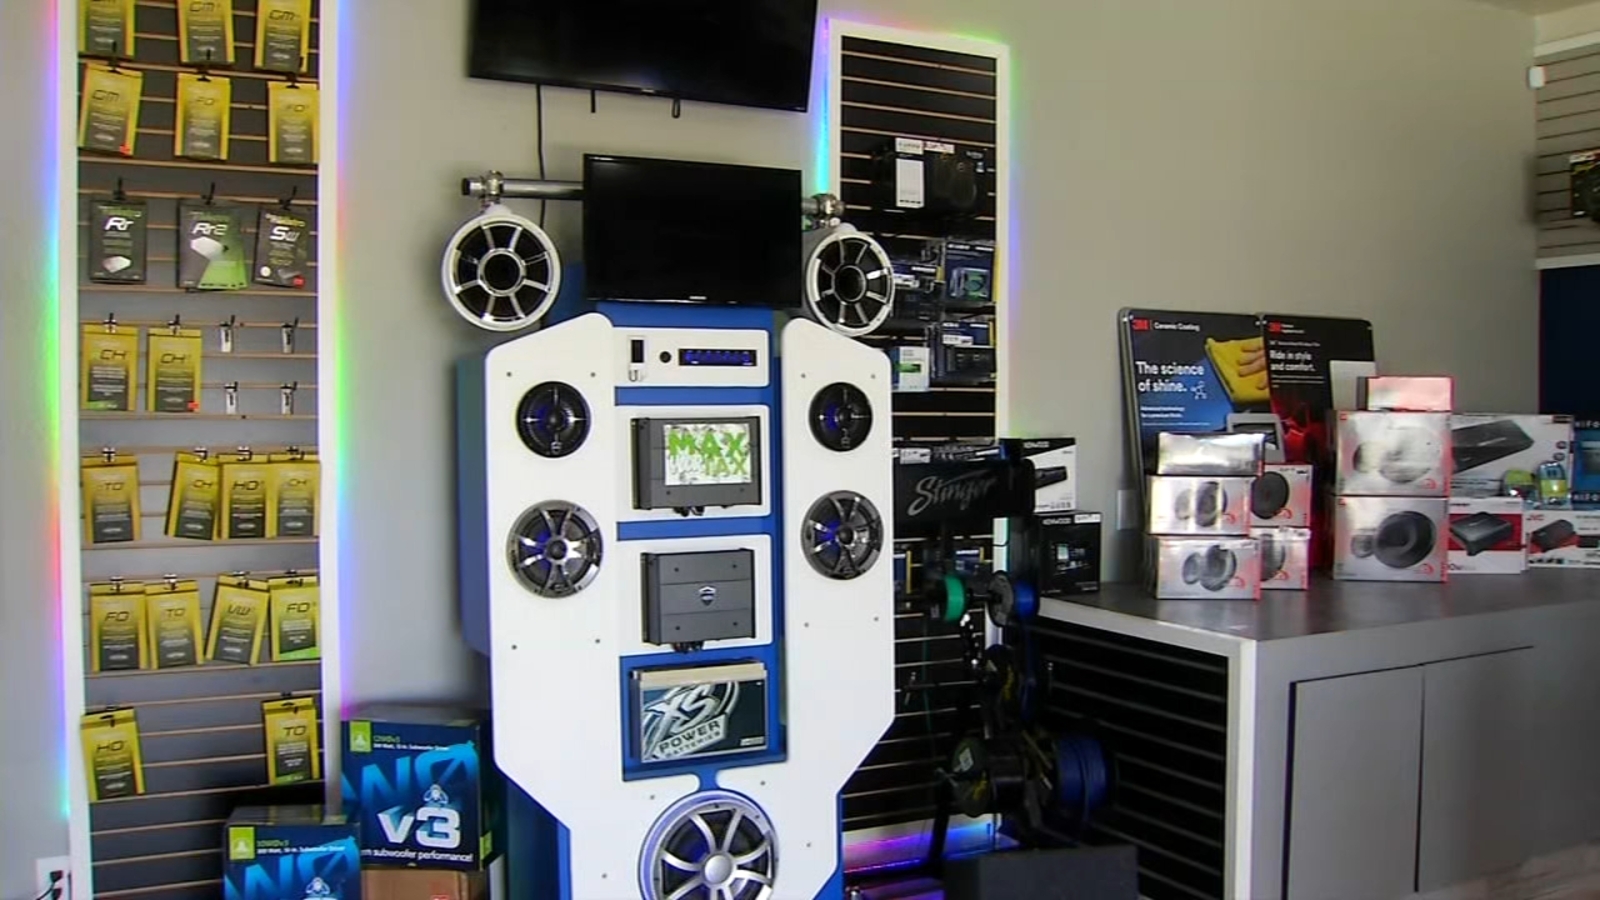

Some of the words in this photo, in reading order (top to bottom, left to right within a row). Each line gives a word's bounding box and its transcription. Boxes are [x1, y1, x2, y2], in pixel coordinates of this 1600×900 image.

[1269, 350, 1286, 360] Ride
[1135, 361, 1159, 375] The
[1160, 362, 1205, 375] science
[1138, 378, 1151, 392] of
[1153, 378, 1188, 392] shine.
[907, 469, 999, 516] Stinger
[659, 721, 721, 754] POWER
[376, 805, 461, 849] v3
[373, 848, 417, 860] subwoofer
[417, 850, 474, 863] performance!
